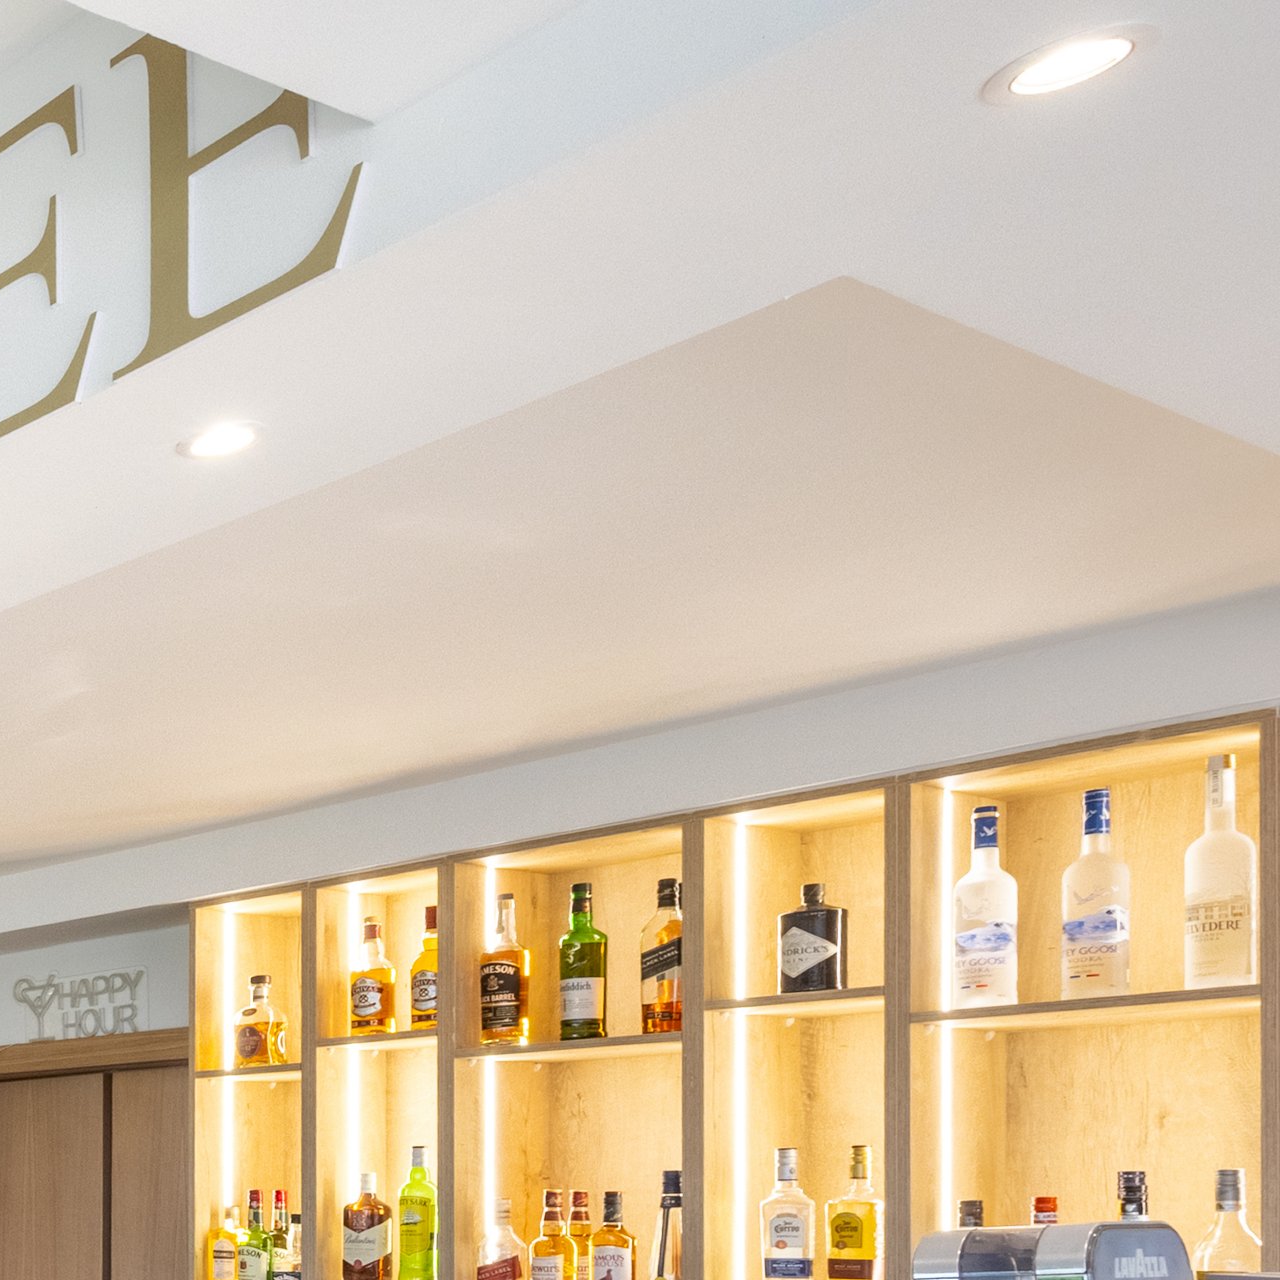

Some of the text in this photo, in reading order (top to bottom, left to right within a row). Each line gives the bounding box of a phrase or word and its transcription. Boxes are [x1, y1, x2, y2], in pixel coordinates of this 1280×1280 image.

[58, 970, 144, 1010] HAPPY
[491, 993, 516, 1001] BARREL
[63, 1003, 138, 1040] HOUR
[1114, 1248, 1169, 1279] LAVAZZA
